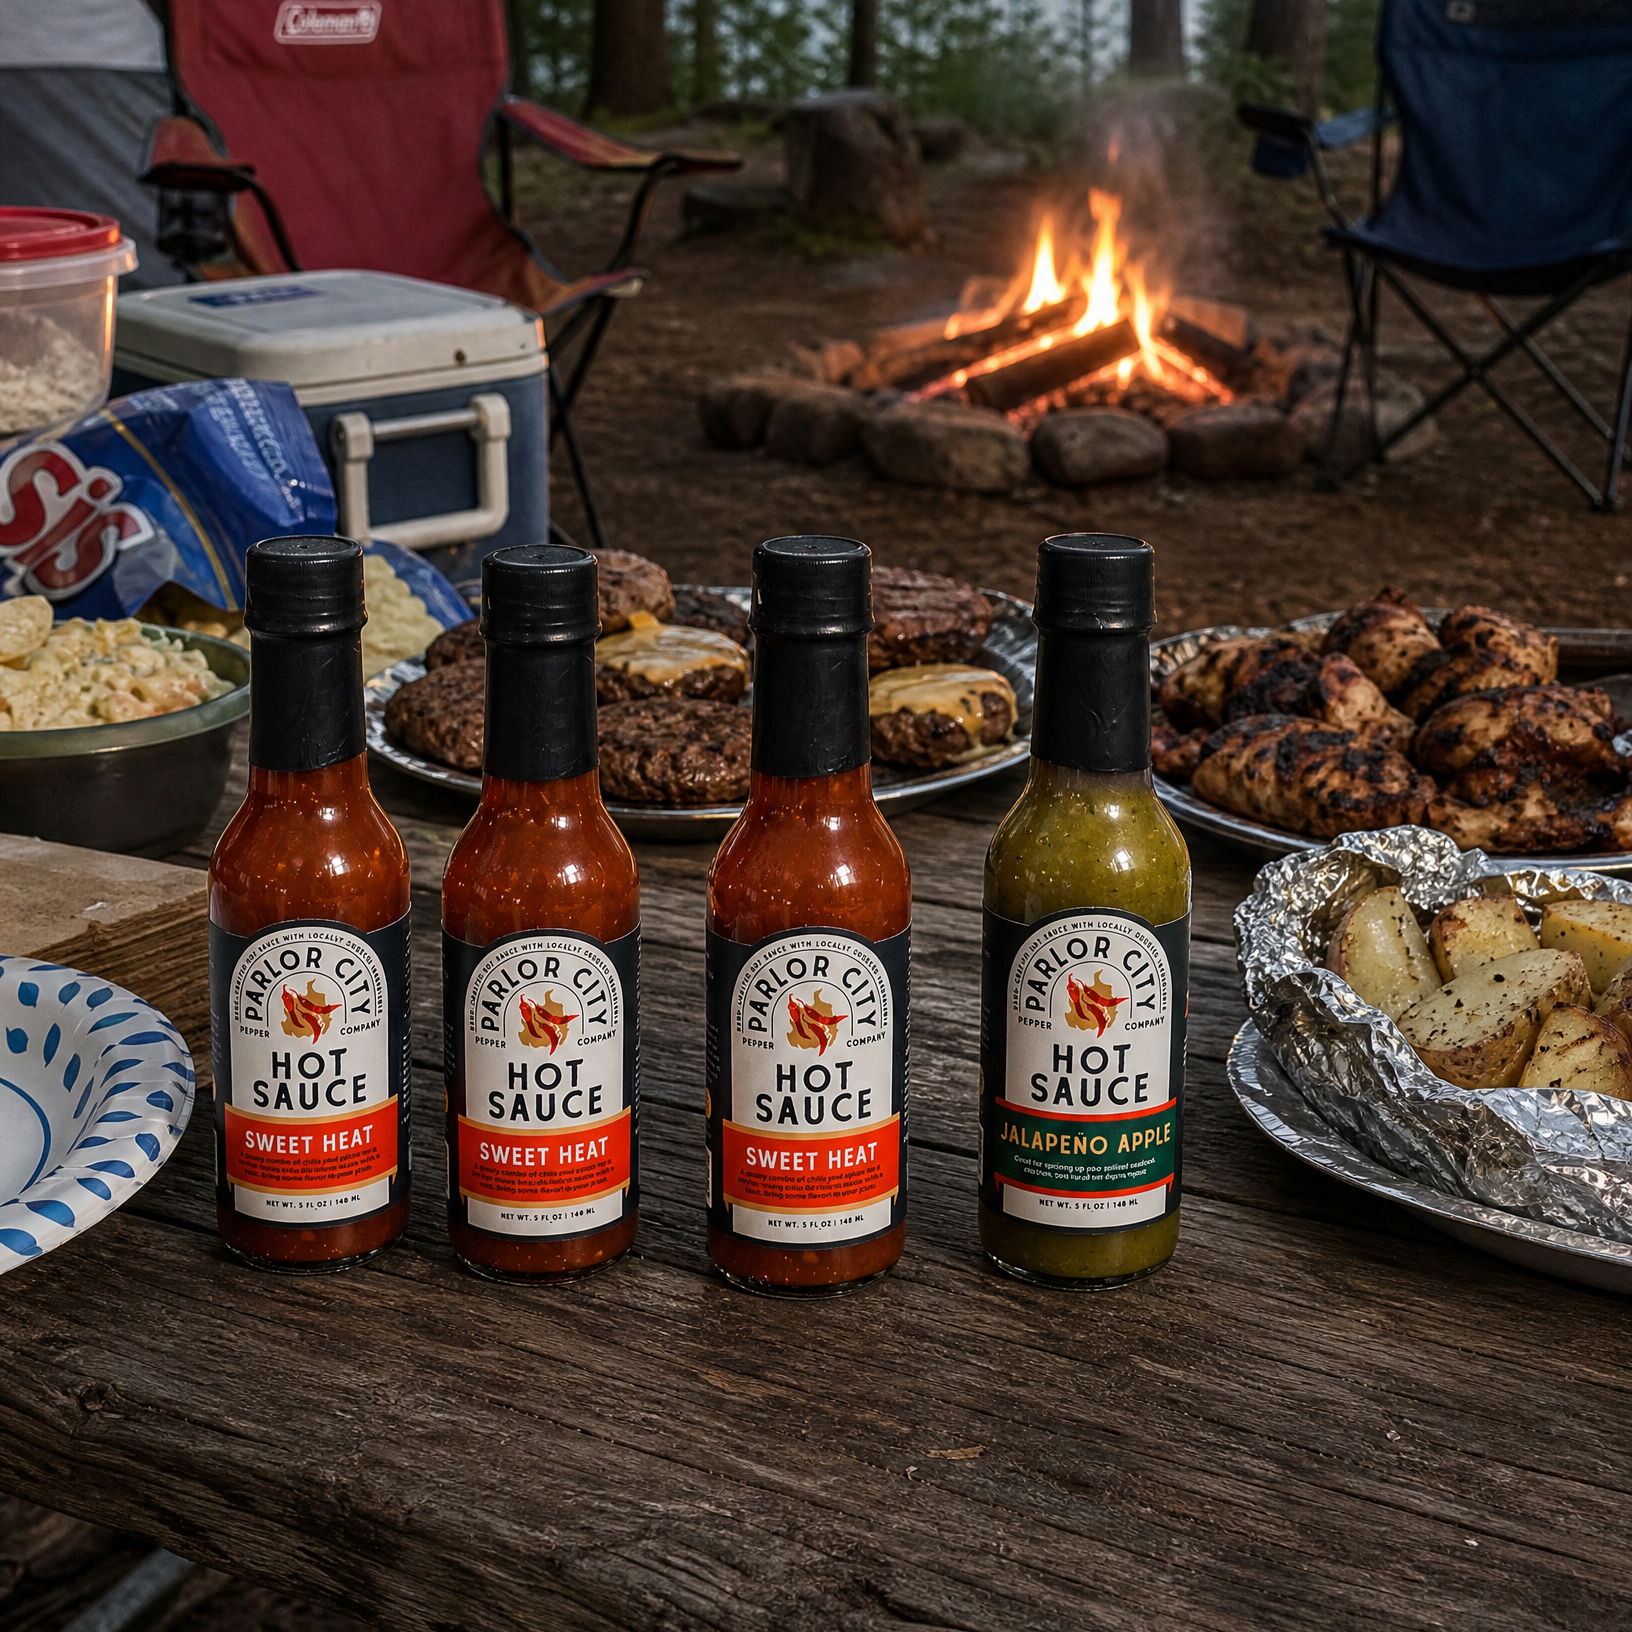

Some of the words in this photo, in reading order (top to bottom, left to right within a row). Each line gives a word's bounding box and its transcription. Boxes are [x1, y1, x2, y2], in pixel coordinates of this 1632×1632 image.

[283, 933, 304, 942] WITH
[1071, 921, 1093, 930] WITH
[1097, 921, 1133, 934] LOCALLY
[521, 942, 543, 951] WITH
[789, 941, 811, 949] WITH
[245, 947, 322, 1021] PARLOR
[335, 958, 370, 1015] CITY
[1025, 936, 1110, 1012] PARLOR
[1123, 950, 1156, 1010] CITY
[481, 957, 560, 1031] PARLOR
[573, 968, 607, 1025] CITY
[748, 955, 829, 1032] PARLOR
[842, 968, 877, 1027] CITY
[240, 1025, 270, 1038] PEPPER
[340, 1018, 381, 1035] COMPANY
[475, 1036, 506, 1048] PEPPER
[577, 1029, 616, 1046] COMPANY
[1018, 1016, 1052, 1030] PEPPER
[1125, 1016, 1165, 1031] COMPANY
[742, 1037, 774, 1049] PEPPER
[846, 1031, 886, 1047] COMPANY
[272, 1048, 347, 1080] HOT
[1053, 1043, 1131, 1074] HOT
[508, 1058, 583, 1090] HOT
[776, 1061, 853, 1092] HOT
[253, 1073, 366, 1110] SAUCE
[489, 1085, 602, 1121] SAUCE
[1031, 1072, 1148, 1107] SAUCE
[756, 1088, 871, 1125] SAUCE
[245, 1130, 313, 1154] SWEET
[323, 1124, 373, 1152] HEAT
[480, 1142, 549, 1166] SWEET
[559, 1136, 608, 1164] HEAT
[1117, 1122, 1171, 1153] APPLE
[746, 1146, 818, 1171] SWEET
[828, 1141, 877, 1169] HEAT
[501, 1212, 514, 1220] NET
[1039, 1199, 1054, 1207] NET
[1057, 1201, 1071, 1209] WT.
[768, 1219, 782, 1227] NET
